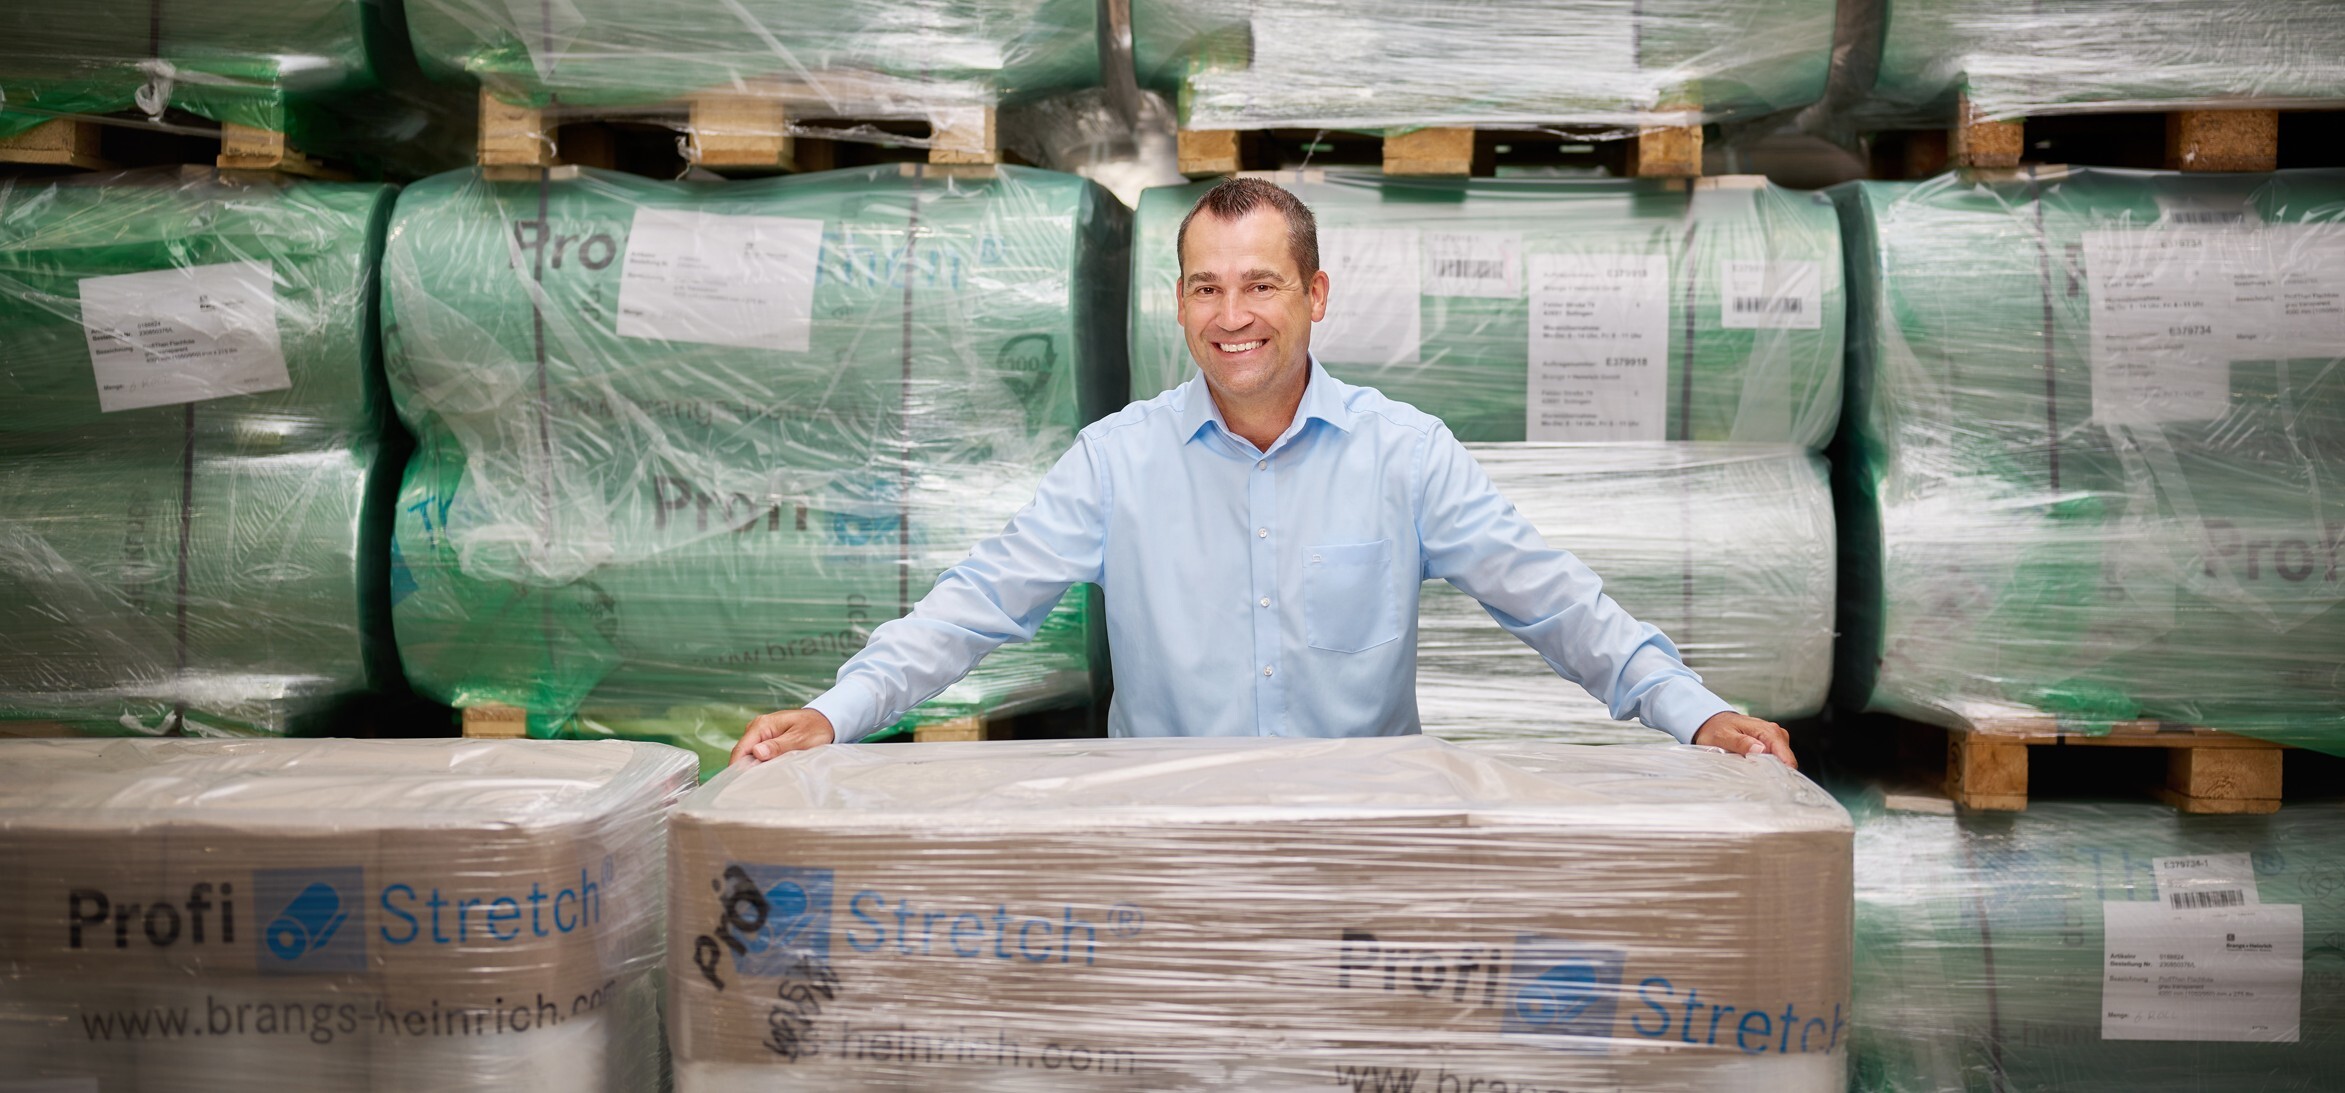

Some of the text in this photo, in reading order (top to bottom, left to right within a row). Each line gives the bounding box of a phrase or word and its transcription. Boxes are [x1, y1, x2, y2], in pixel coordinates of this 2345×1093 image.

[1605, 356, 1649, 367] E379918
[67, 881, 236, 951] Profi
[1337, 927, 1501, 1008] Profi
